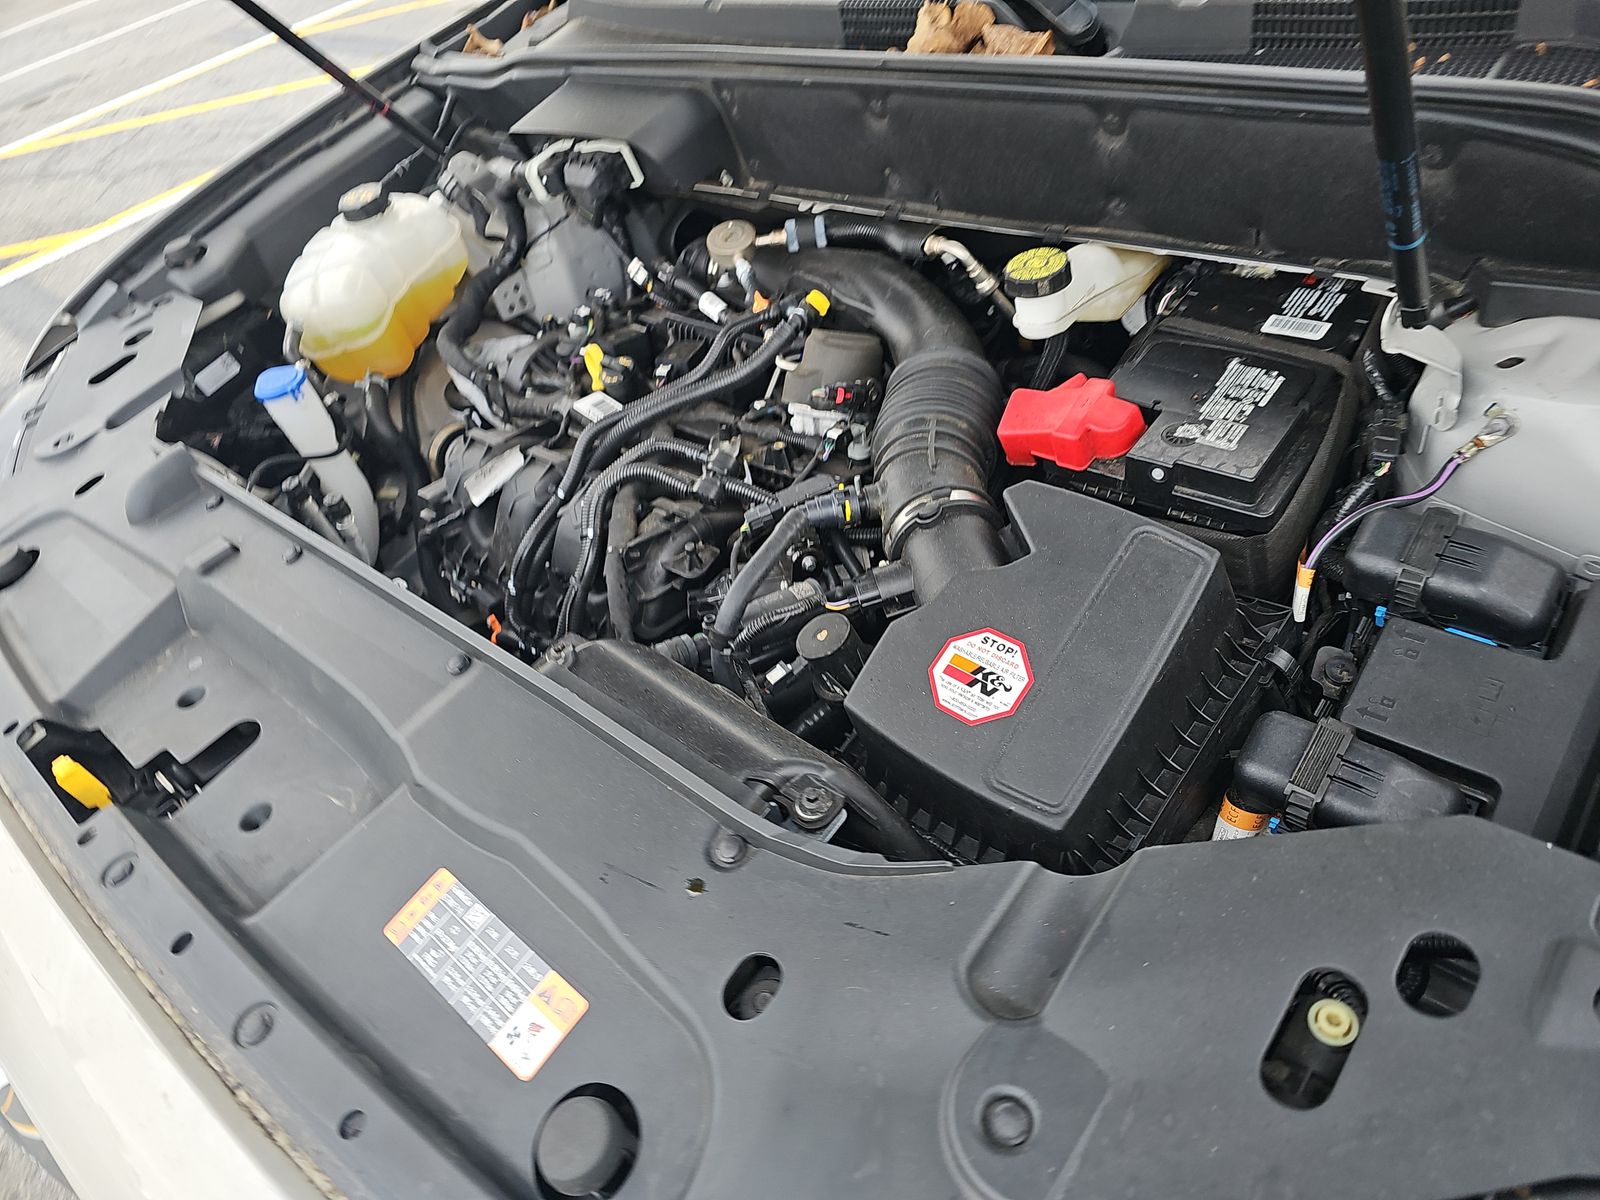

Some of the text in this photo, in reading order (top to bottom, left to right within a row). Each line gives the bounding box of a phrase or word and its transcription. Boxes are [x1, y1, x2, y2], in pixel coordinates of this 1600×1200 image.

[966, 641, 1020, 670] DO NOT DISCARD
[981, 635, 1018, 659] STOP!
